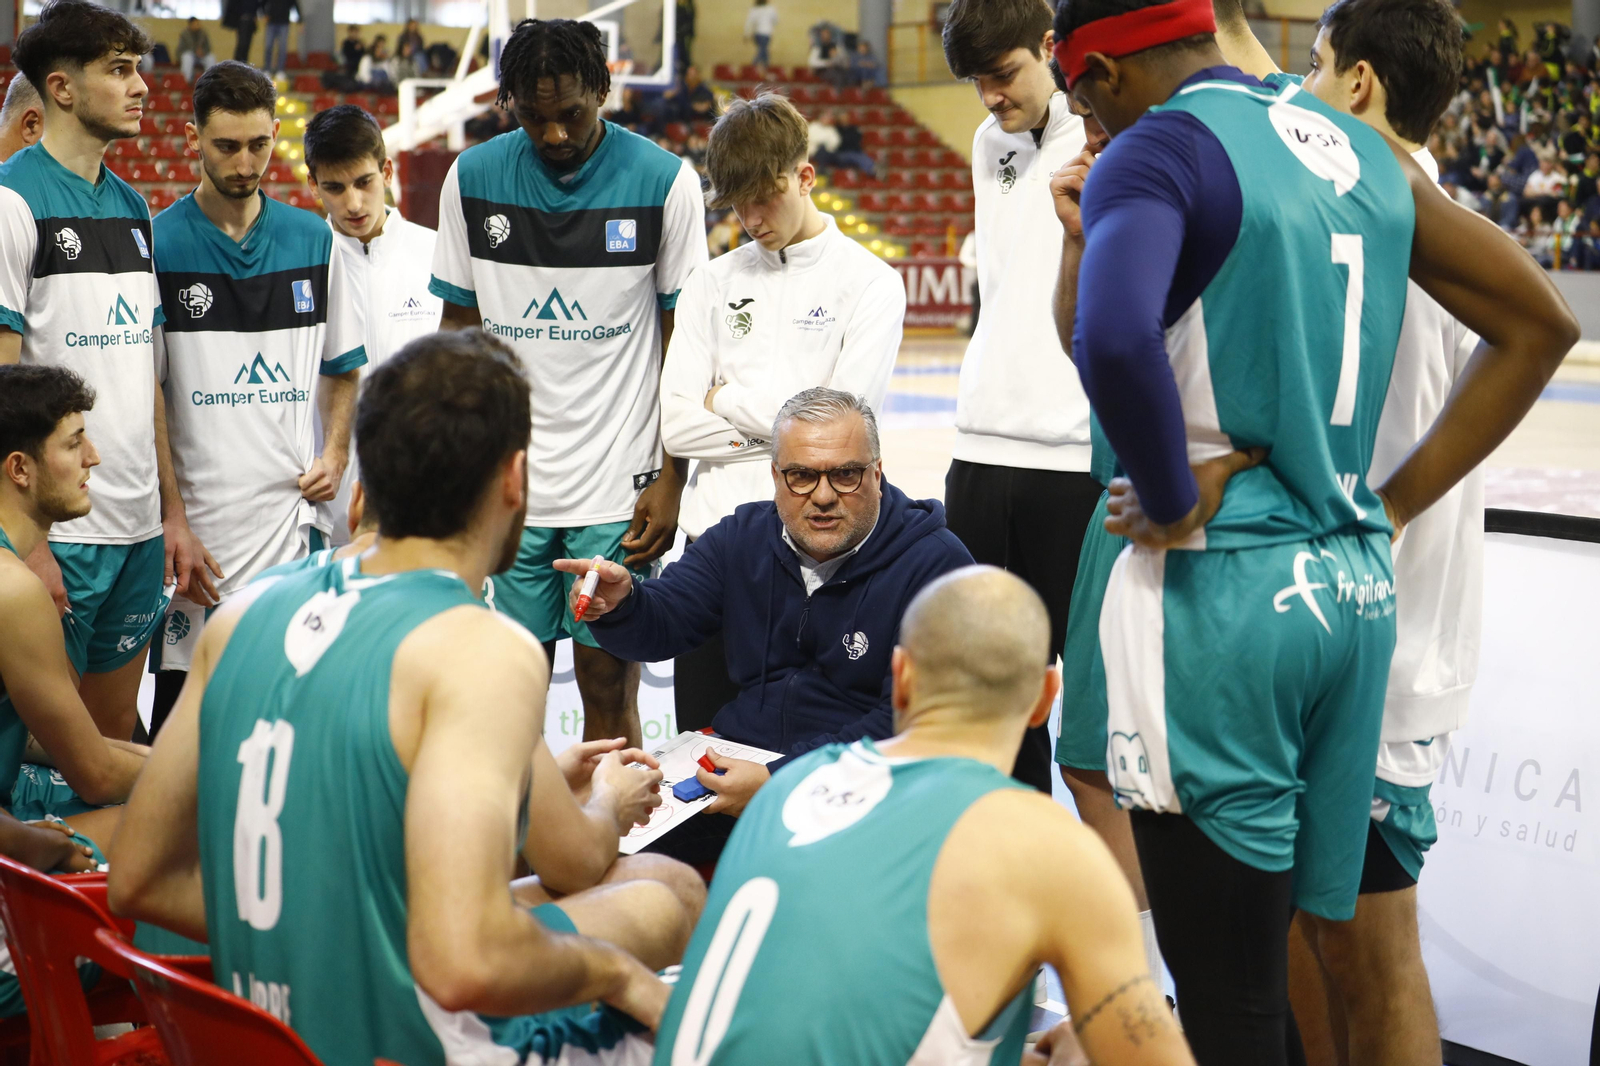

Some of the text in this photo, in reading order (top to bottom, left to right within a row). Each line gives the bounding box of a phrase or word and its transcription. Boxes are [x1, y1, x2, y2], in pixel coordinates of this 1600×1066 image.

[609, 240, 629, 249] EBA
[483, 318, 632, 341] Camper EuroGaza
[65, 331, 121, 350] Camper
[191, 390, 255, 407] Camper
[233, 718, 295, 931] 18
[1473, 814, 1488, 838] y
[1499, 821, 1578, 853] salud
